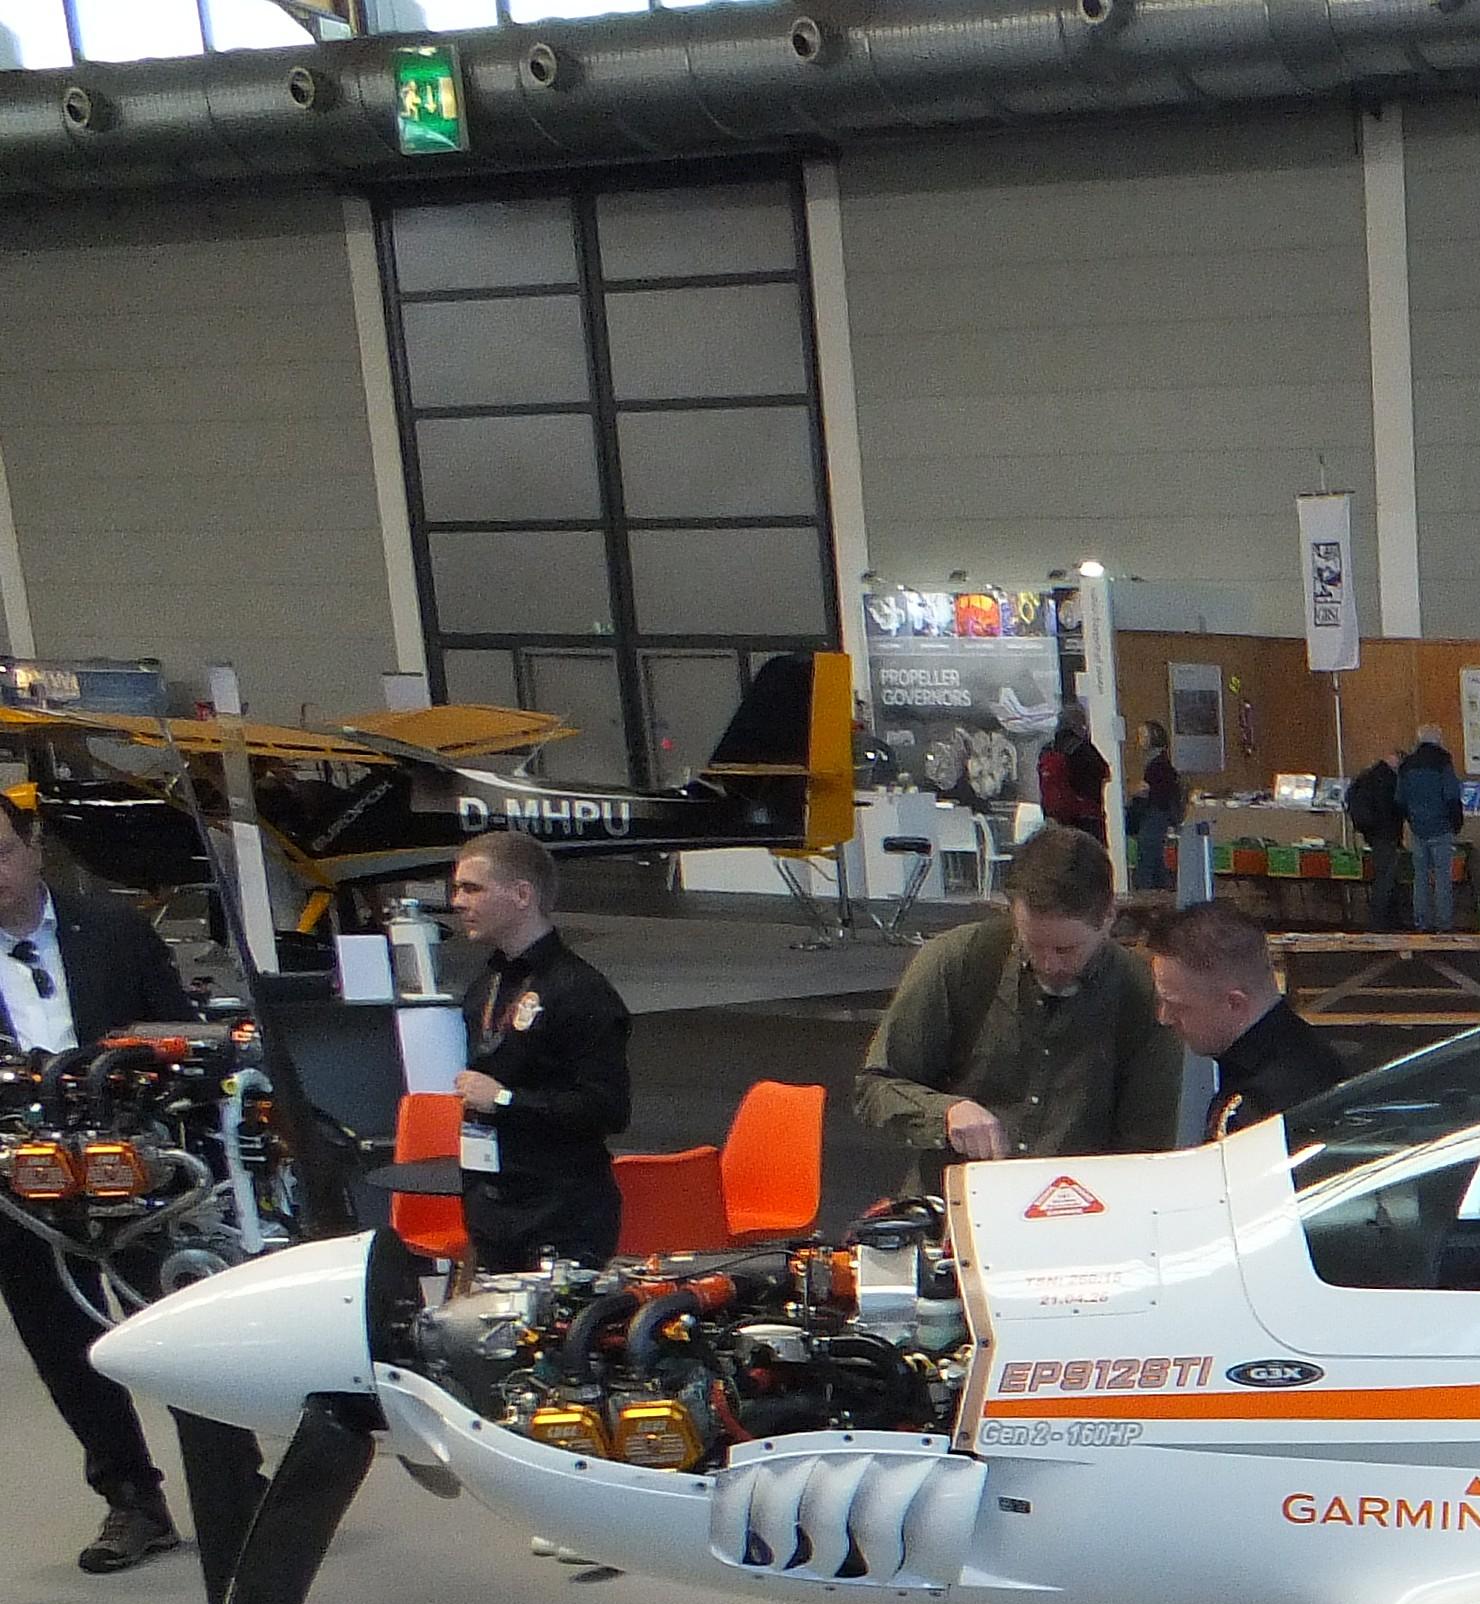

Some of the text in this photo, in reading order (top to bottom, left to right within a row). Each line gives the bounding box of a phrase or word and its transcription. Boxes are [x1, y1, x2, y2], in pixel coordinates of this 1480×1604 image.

[880, 669, 961, 686] PROPELLER
[883, 689, 972, 707] GOVERNORS
[459, 797, 630, 837] D-MHPU
[1249, 1366, 1302, 1381] G3X
[981, 1421, 1029, 1446] Gen
[1030, 1422, 1049, 1446] 2
[1067, 1421, 1144, 1446] 160HP
